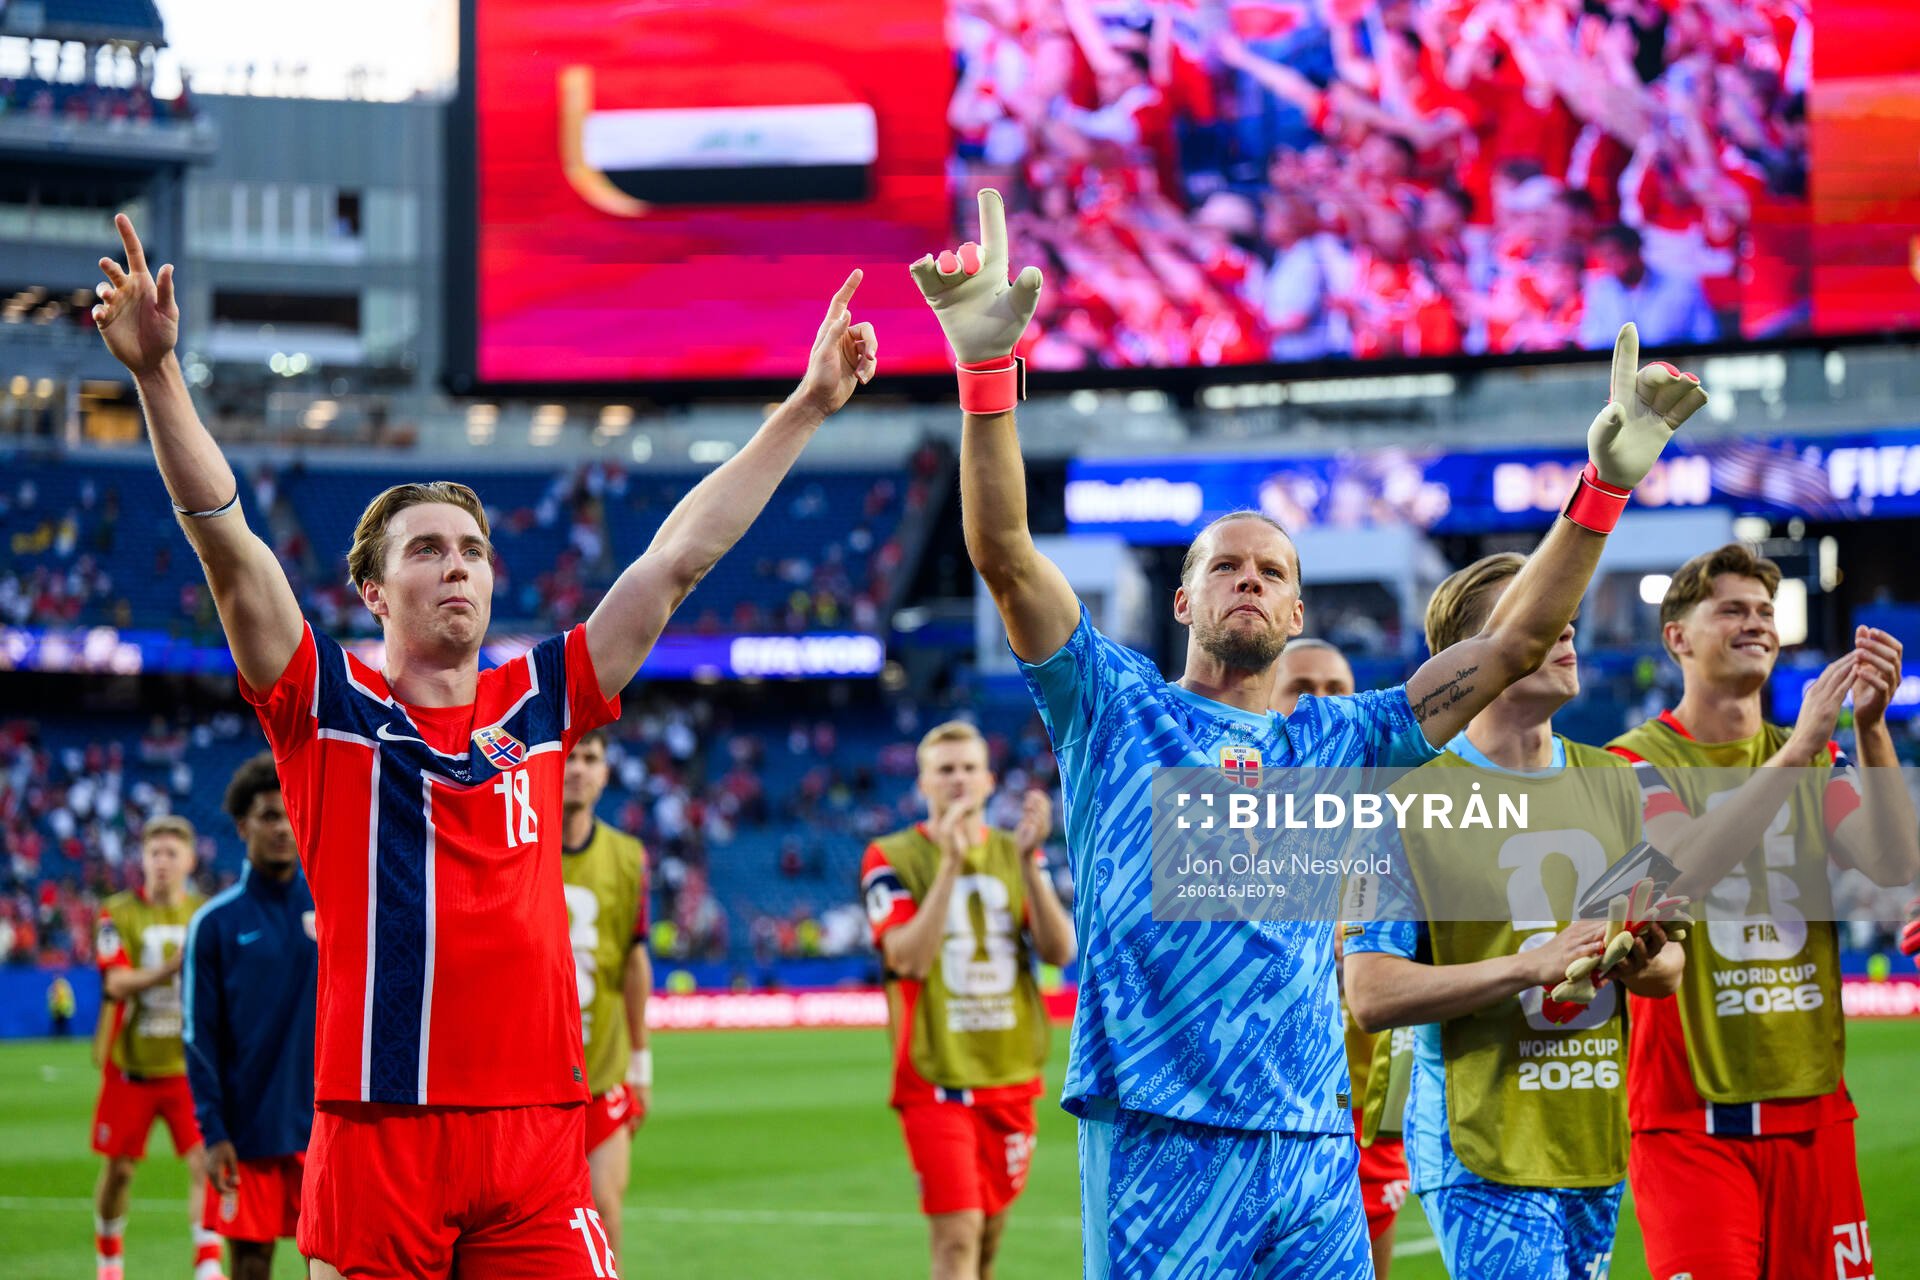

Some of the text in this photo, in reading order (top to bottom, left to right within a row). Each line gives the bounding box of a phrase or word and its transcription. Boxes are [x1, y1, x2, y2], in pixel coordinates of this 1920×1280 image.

[494, 769, 539, 848] 18
[1779, 963, 1817, 983] CUP
[1715, 984, 1824, 1017] 2026
[1519, 1039, 1619, 1057] WORLD CUP
[1518, 1060, 1620, 1091] 2026
